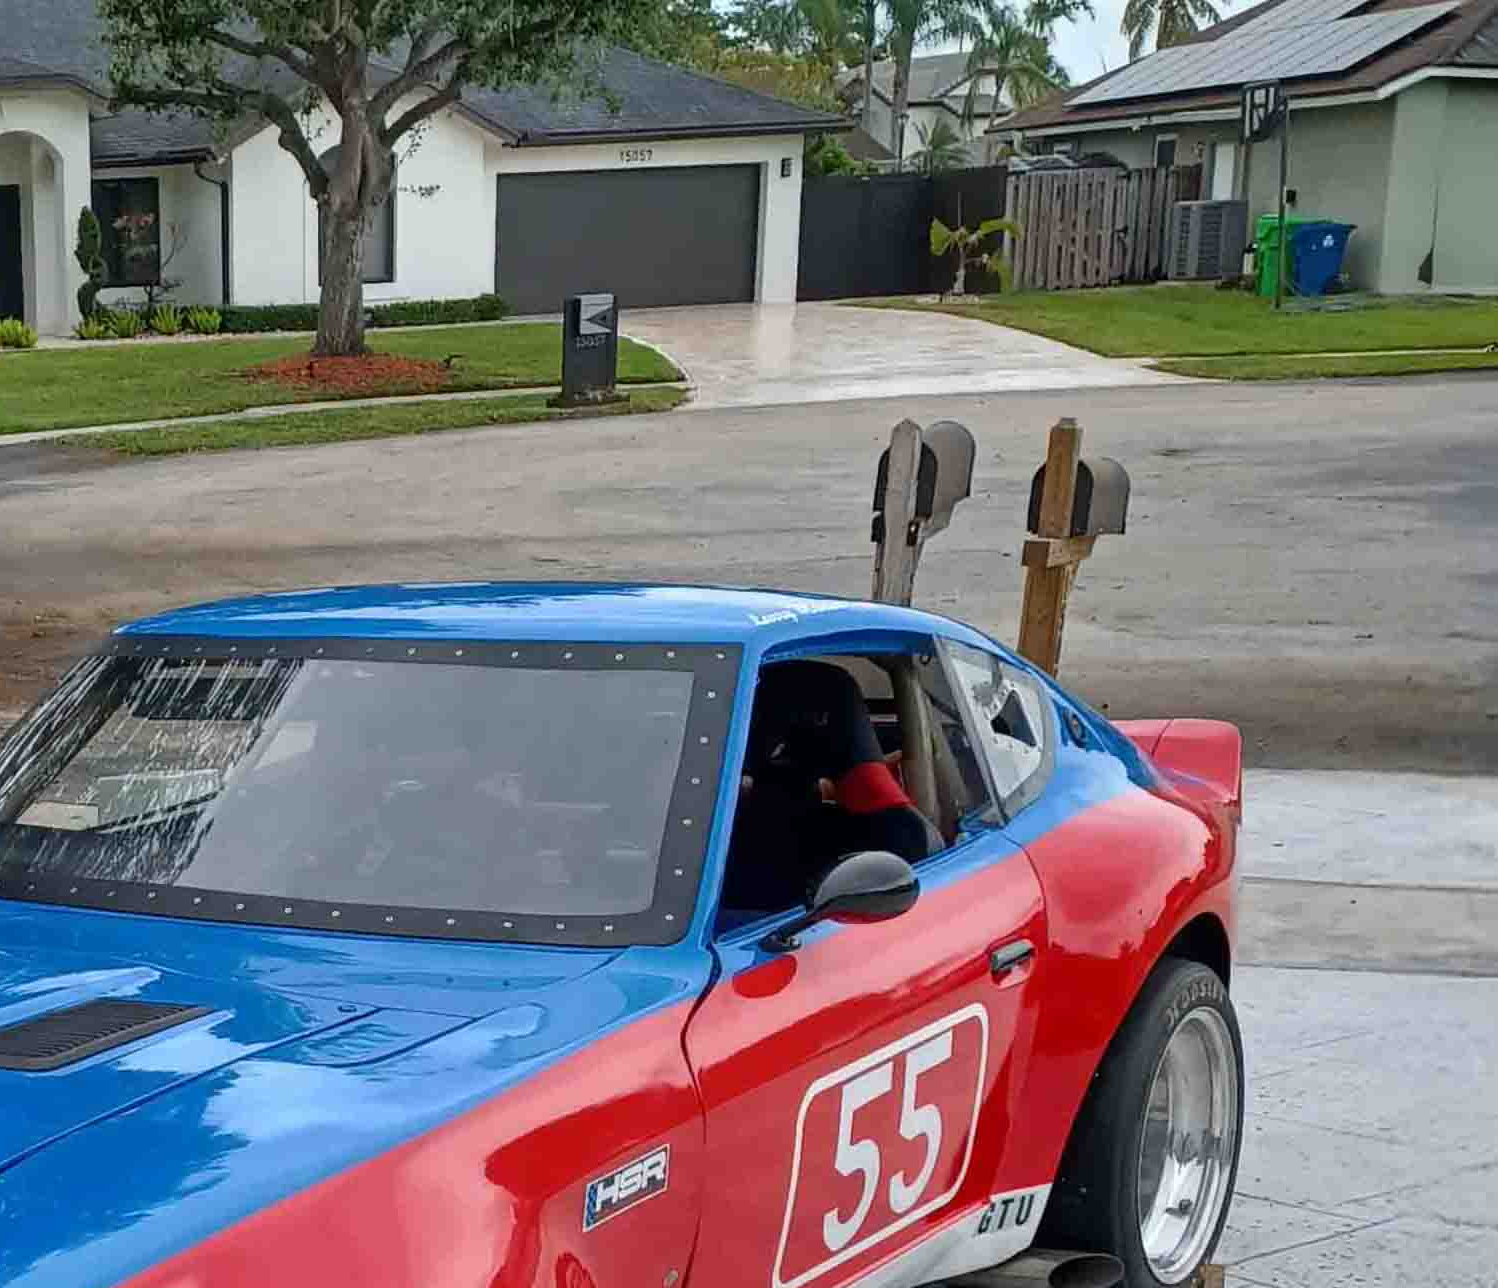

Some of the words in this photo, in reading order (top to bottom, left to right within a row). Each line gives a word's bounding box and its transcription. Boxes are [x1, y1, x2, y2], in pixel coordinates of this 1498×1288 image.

[822, 1029, 953, 1251] 55
[596, 1151, 666, 1211] HSR
[978, 1194, 1035, 1234] GTU
